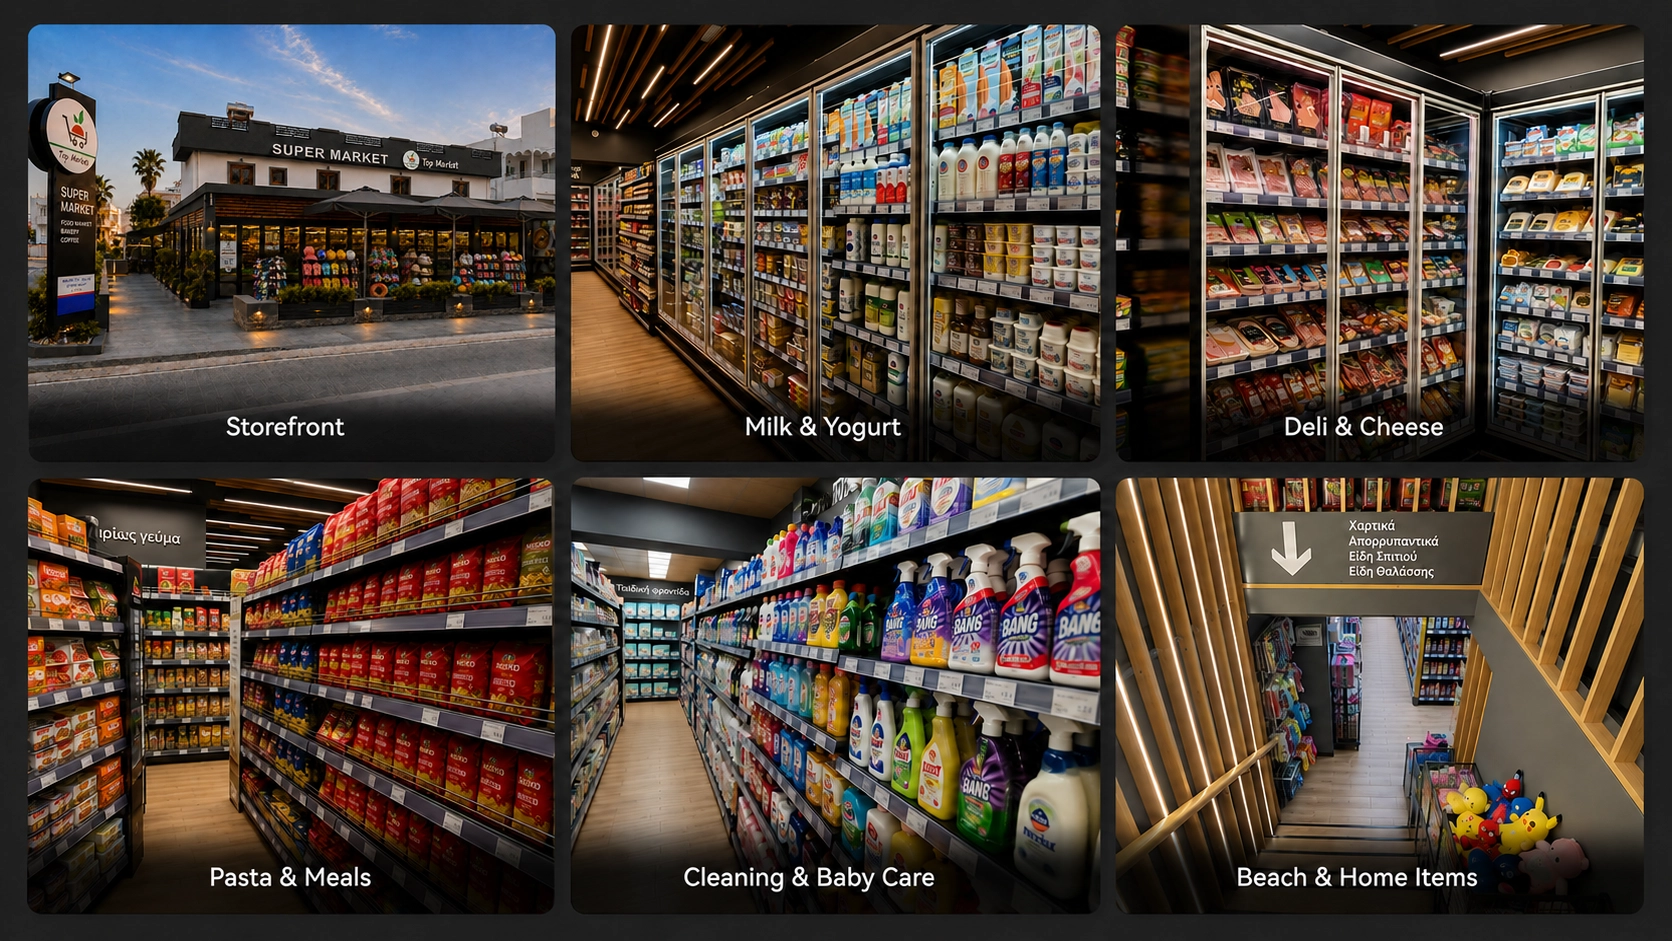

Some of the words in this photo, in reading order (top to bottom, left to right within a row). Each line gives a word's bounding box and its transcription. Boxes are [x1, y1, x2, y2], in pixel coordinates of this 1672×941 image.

[272, 143, 325, 158] SUPER
[330, 148, 388, 164] MARKET
[422, 157, 434, 169] Top
[60, 186, 90, 201] SUPER
[60, 201, 95, 216] MARKET
[1348, 519, 1396, 533] Χαρτικά
[140, 530, 181, 546] γεύμα
[1348, 535, 1439, 549] Απορρυπαντικά
[1349, 550, 1374, 564] Είδη
[1376, 550, 1418, 562] Σπιτιού
[1349, 566, 1374, 578] Είδη
[1376, 565, 1435, 579] Θαλάσσης
[953, 614, 983, 636] BANG
[1002, 612, 1039, 637] BANG
